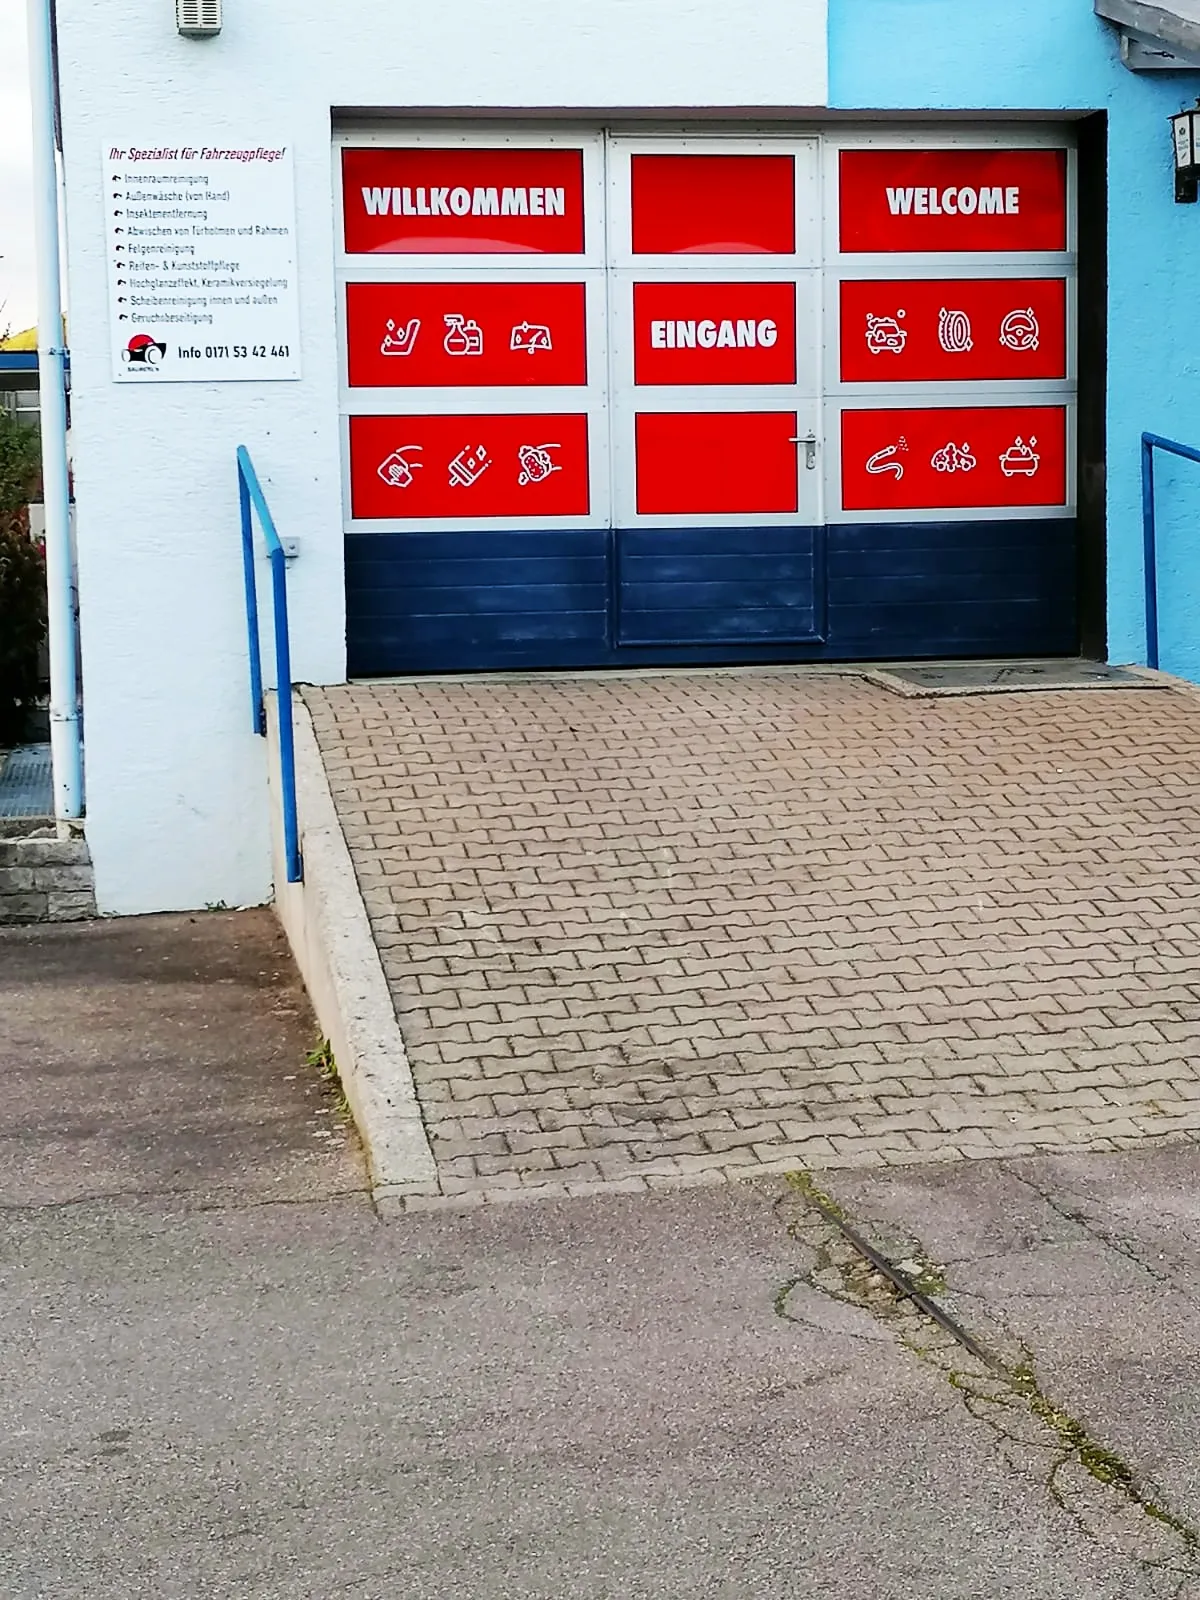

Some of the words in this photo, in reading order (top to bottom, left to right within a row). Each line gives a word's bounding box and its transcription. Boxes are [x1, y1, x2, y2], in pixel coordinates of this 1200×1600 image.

[109, 147, 126, 160] Ihr
[128, 147, 178, 162] Spezialist
[180, 147, 200, 160] für
[200, 147, 287, 162] Fahrzeugpflege!
[124, 174, 209, 186] Innenraumreinigung
[125, 190, 183, 201] Außenwäsche
[185, 190, 204, 202] (von
[205, 190, 230, 202] Hand)
[361, 186, 565, 217] WILLKOMMEN
[886, 186, 1019, 215] WELCOME
[126, 208, 208, 221] Insektenentfernung
[127, 226, 172, 236] Abwischen
[237, 225, 253, 236] und
[255, 225, 289, 236] Rahmen
[128, 243, 195, 256] Felgenreinigung
[171, 260, 240, 273] Kunststoffpflege
[201, 277, 288, 289] Keramikversiegelung
[130, 295, 207, 307] Scheibenreinigung
[209, 295, 232, 305] innen
[234, 295, 250, 305] und
[252, 294, 278, 305] außen
[131, 312, 213, 325] Geruchsbeseitigung
[651, 319, 778, 349] EINGANG
[178, 346, 201, 359] Info
[205, 346, 229, 359] 0171
[233, 345, 247, 358] 53
[252, 345, 266, 358] 42
[271, 345, 290, 358] 461
